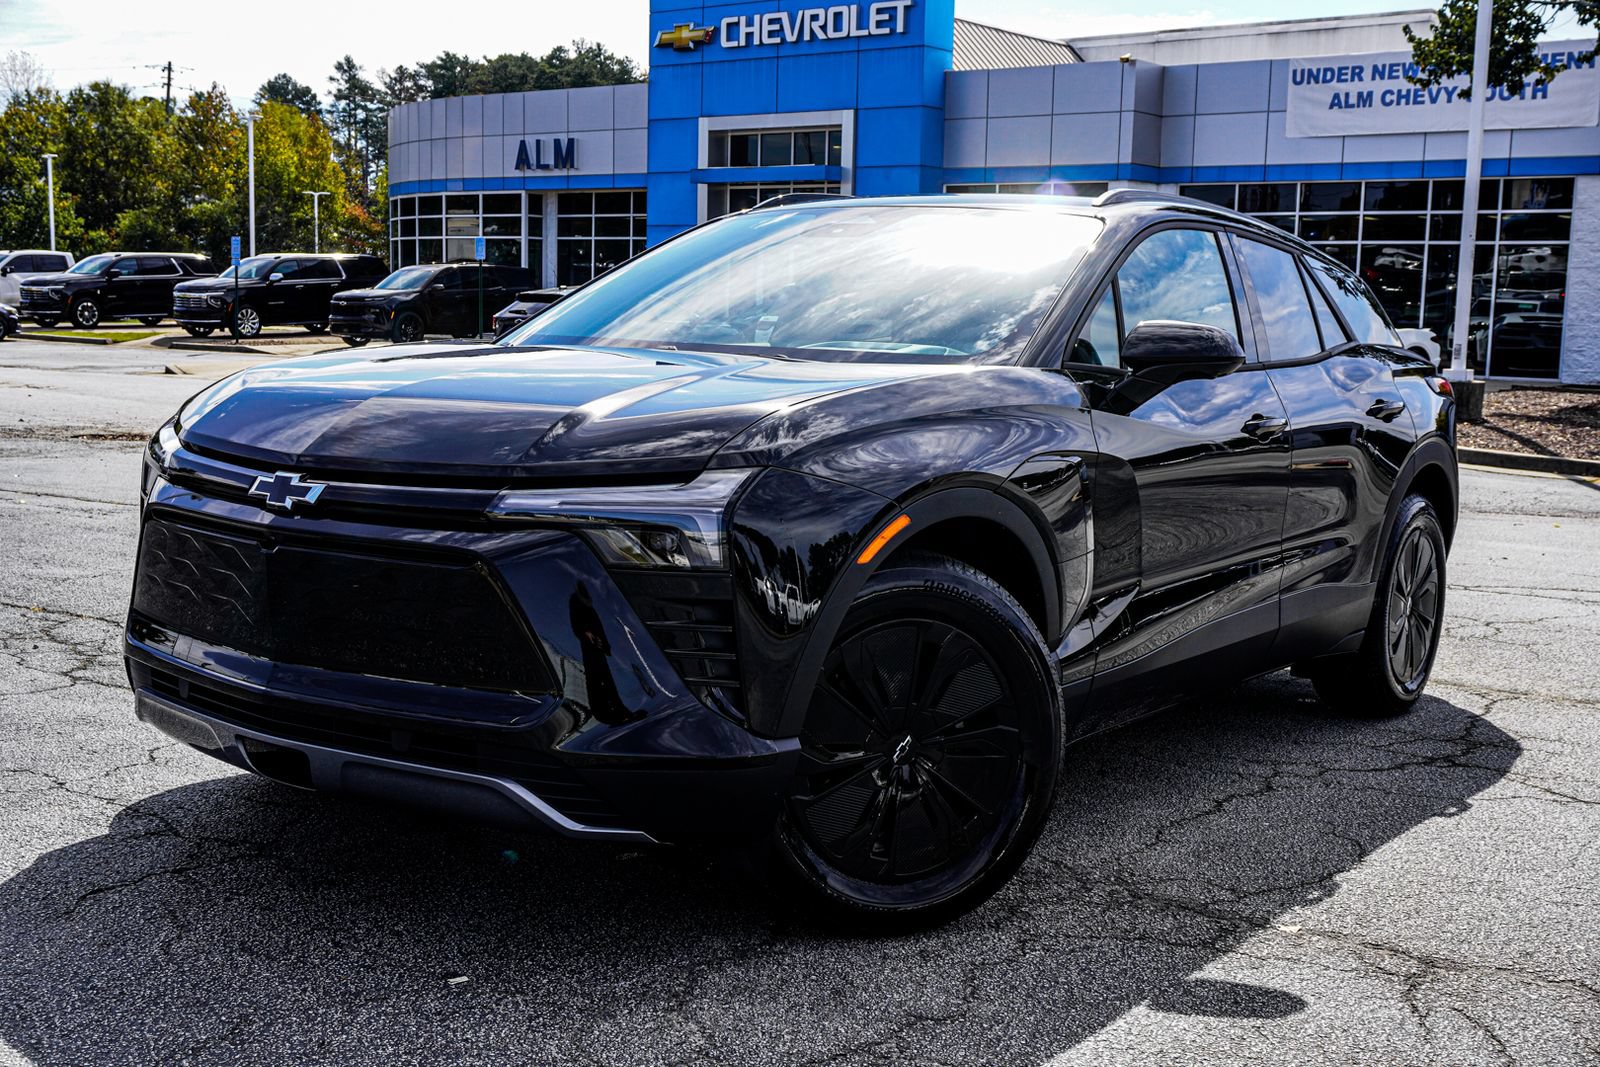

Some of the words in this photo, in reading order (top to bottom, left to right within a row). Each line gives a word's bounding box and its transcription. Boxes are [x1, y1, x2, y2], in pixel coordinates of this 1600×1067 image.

[720, 0, 911, 48] CHEVROLET
[1292, 65, 1364, 86] UNDER
[1371, 62, 1420, 81] NEW
[1328, 90, 1374, 109] ALM
[1380, 86, 1458, 107] CHEVY
[1465, 82, 1548, 103] OUTH
[514, 137, 576, 171] ALM
